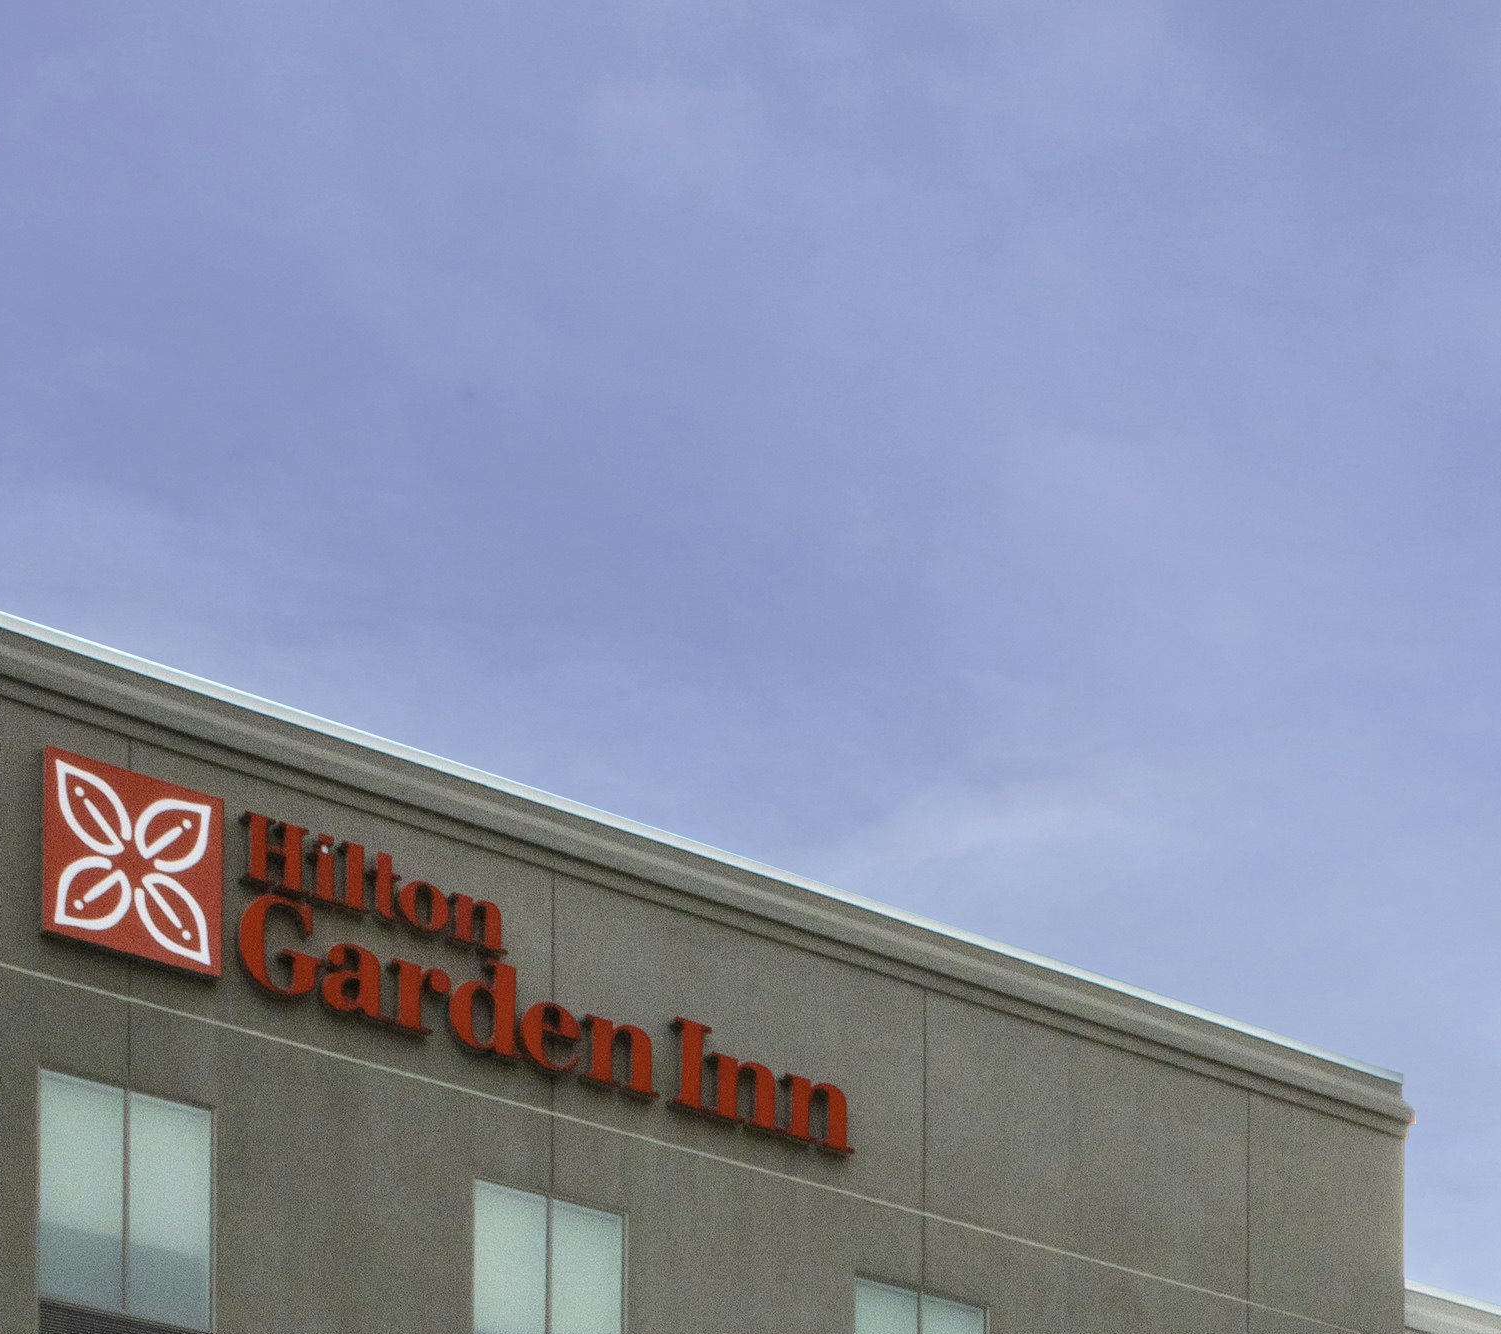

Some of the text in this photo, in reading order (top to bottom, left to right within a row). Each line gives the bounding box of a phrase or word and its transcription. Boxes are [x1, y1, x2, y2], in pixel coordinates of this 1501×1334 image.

[243, 810, 507, 956] Hilton
[238, 894, 855, 1154] Garden Inn
